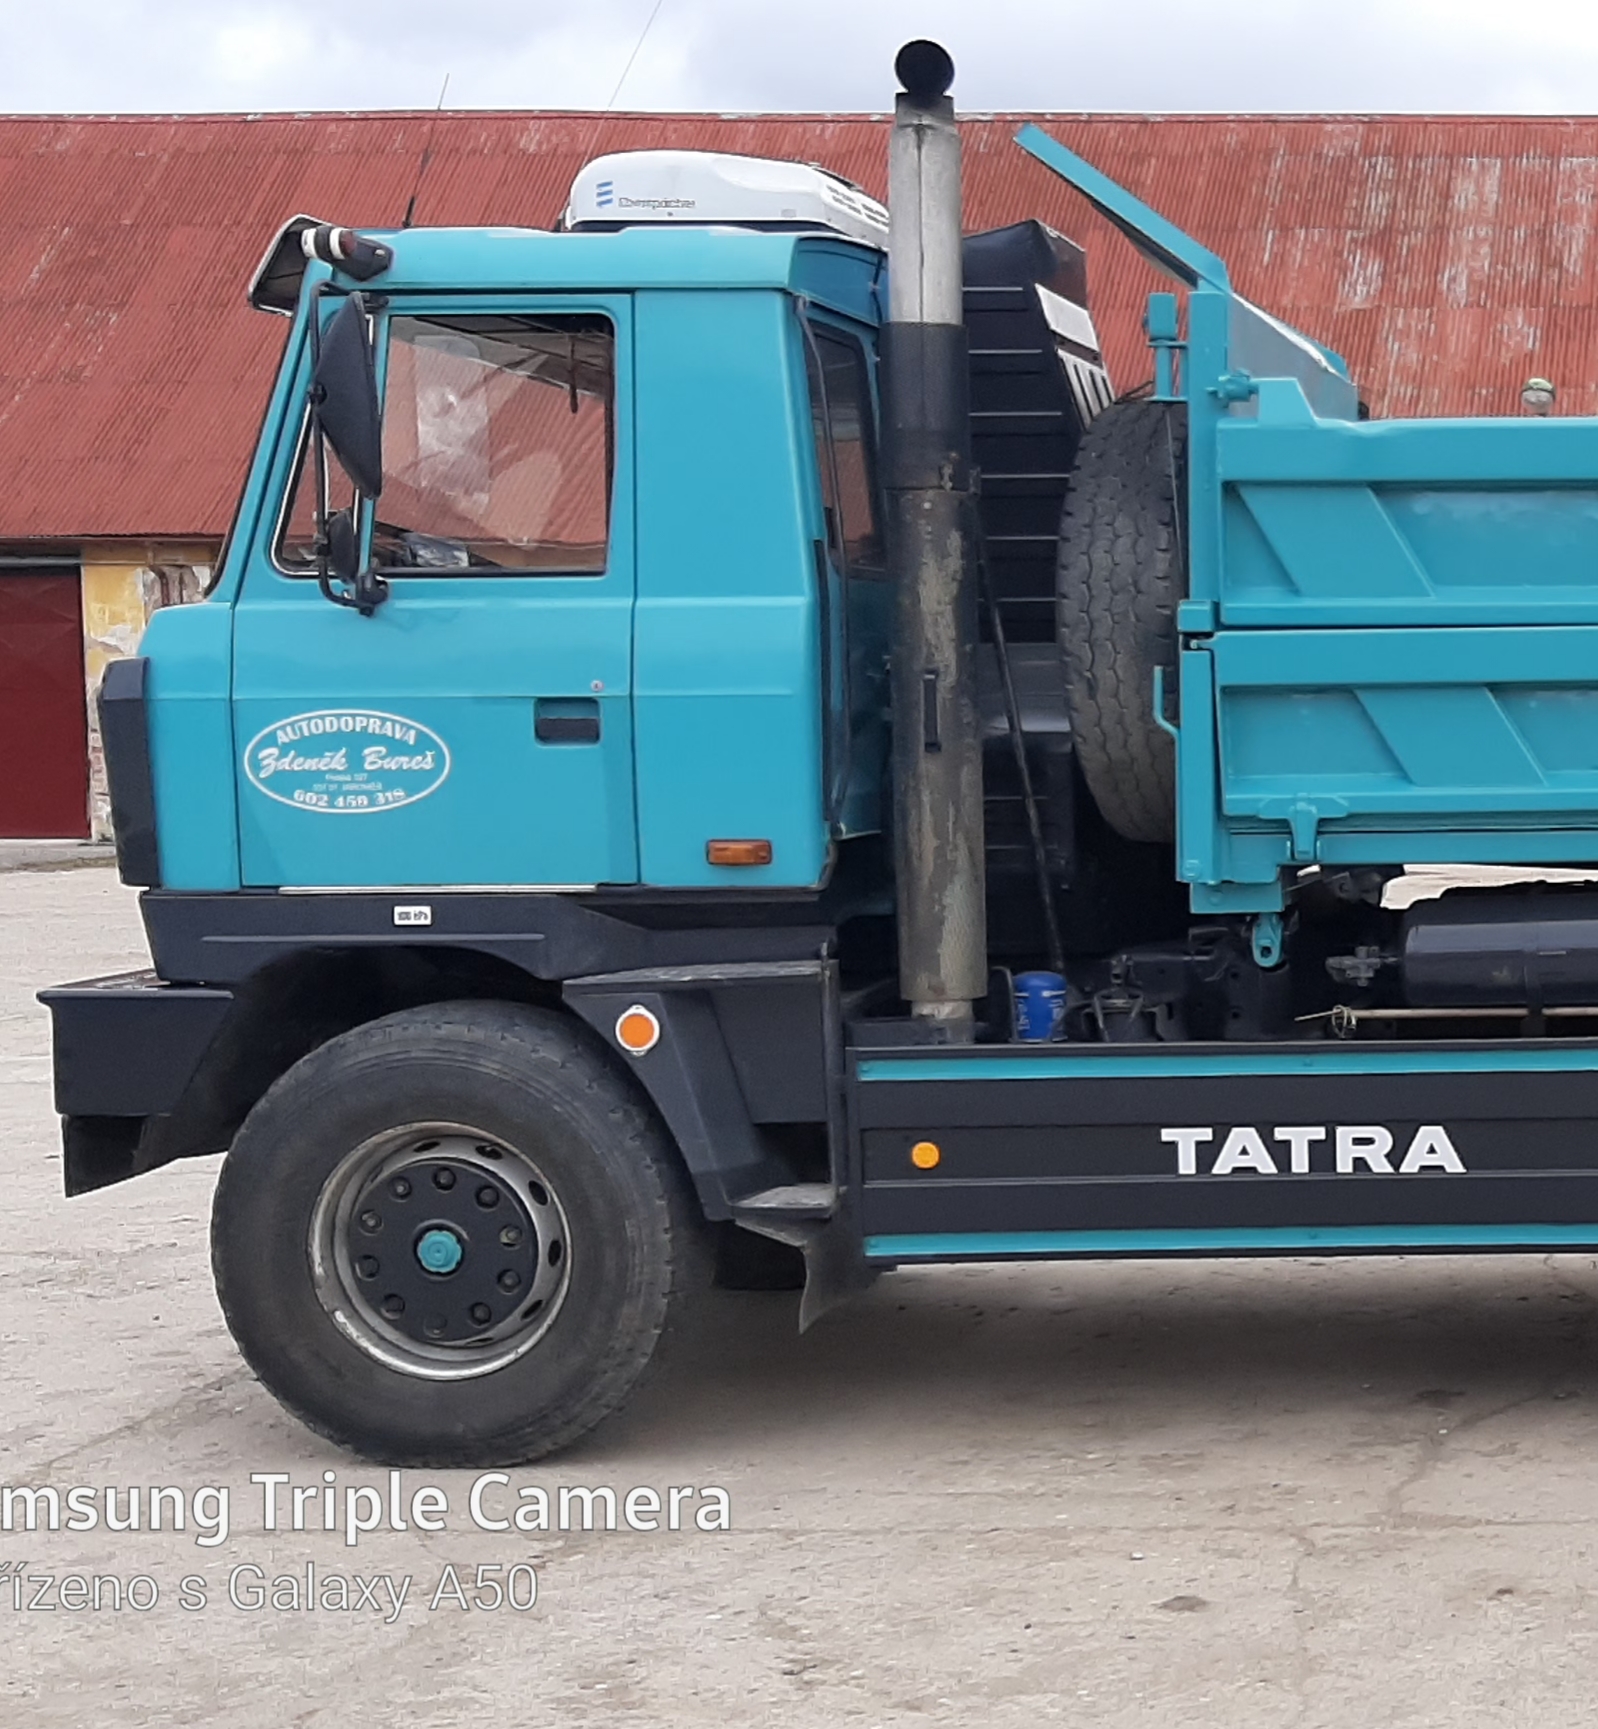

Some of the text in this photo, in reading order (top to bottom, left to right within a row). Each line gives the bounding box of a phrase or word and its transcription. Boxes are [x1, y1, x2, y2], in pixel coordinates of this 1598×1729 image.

[275, 716, 417, 746] AUTODOPRAVA
[258, 746, 436, 778] Zdeněk Bureš
[293, 789, 330, 807] 602
[1160, 1125, 1467, 1175] TATRA
